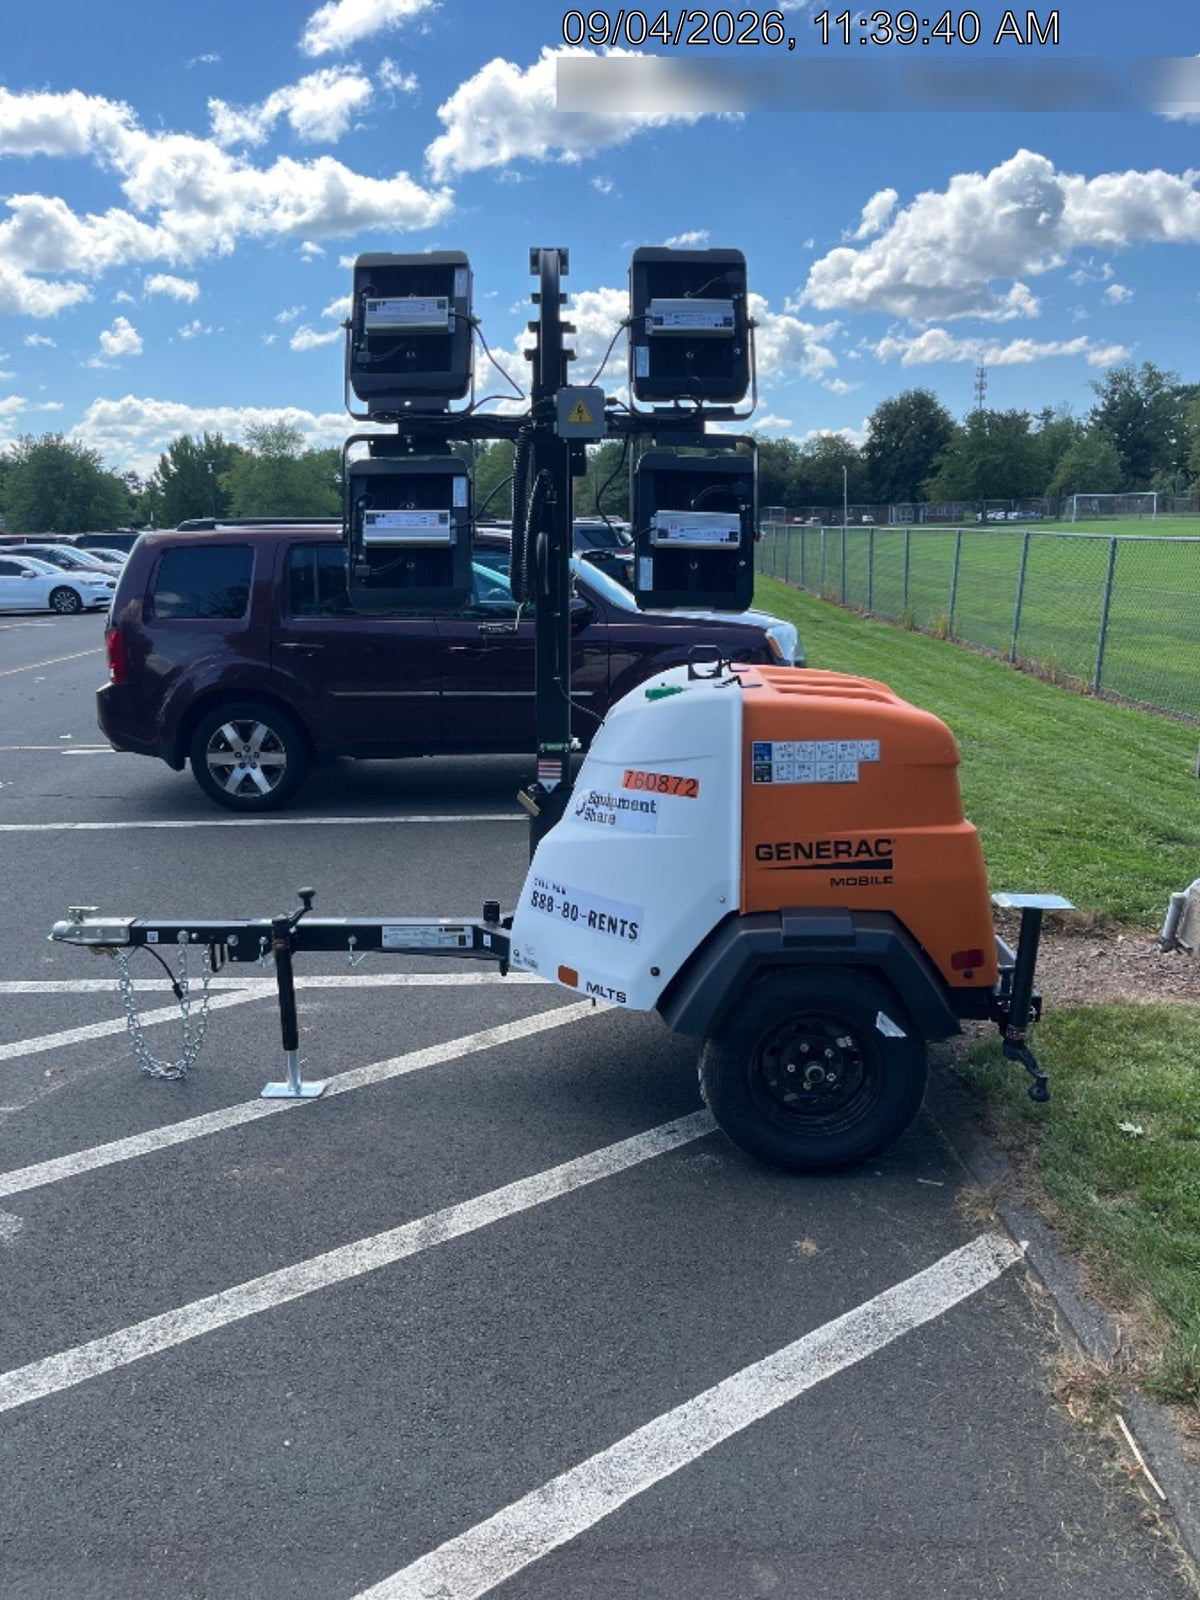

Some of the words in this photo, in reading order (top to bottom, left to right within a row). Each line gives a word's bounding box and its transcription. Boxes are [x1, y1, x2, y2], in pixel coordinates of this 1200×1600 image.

[624, 770, 698, 798] 760872
[587, 790, 657, 813] Equipment
[583, 807, 616, 825] Share
[755, 838, 893, 861] GENERAC
[829, 875, 893, 887] MOBILE
[531, 890, 639, 940] 888-80-RENTS
[586, 981, 627, 1004] MLTS
